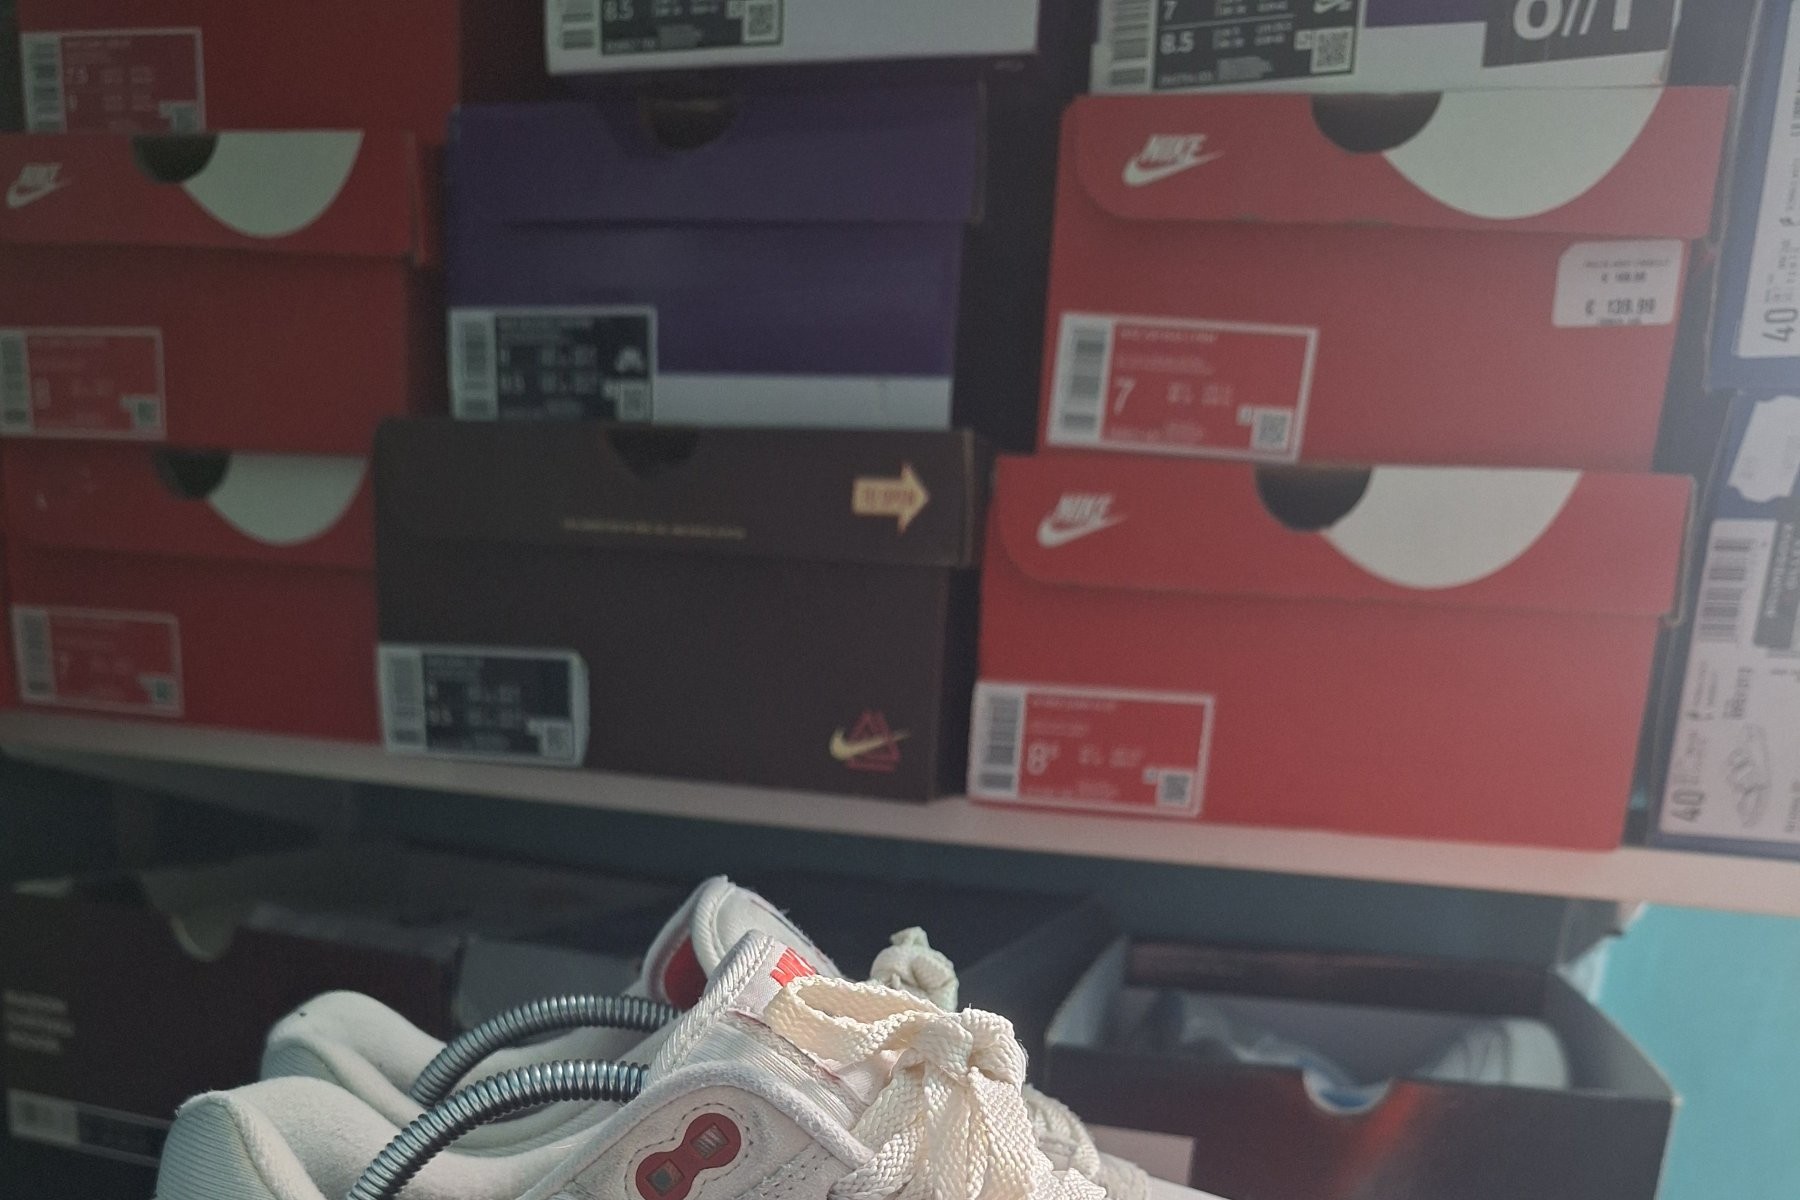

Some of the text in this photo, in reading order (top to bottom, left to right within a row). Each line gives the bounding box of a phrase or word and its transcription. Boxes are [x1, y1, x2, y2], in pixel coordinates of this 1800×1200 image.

[1160, 31, 1195, 55] 8.5
[1138, 134, 1209, 164] NIKE
[1763, 308, 1800, 343] 40
[1114, 378, 1136, 416] 7
[1053, 493, 1114, 522] NIKE
[1671, 789, 1706, 823] 40
